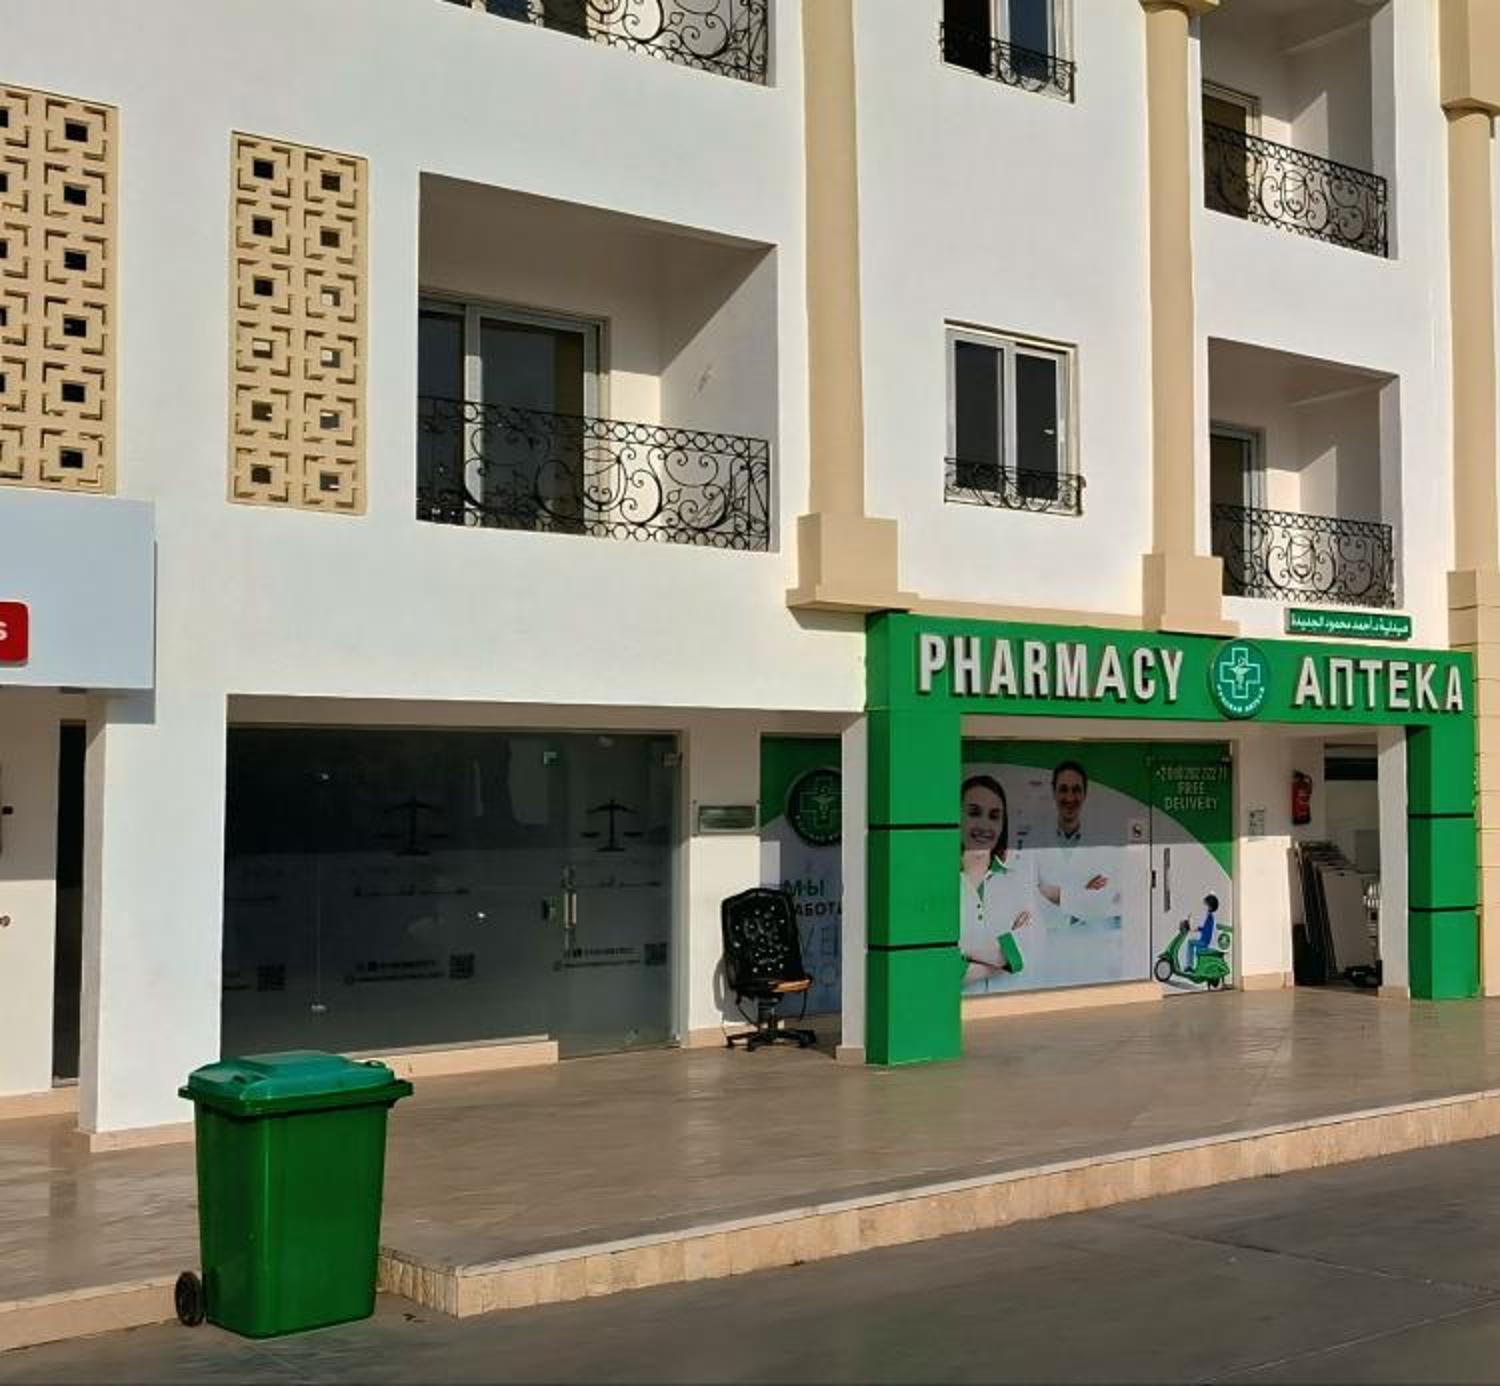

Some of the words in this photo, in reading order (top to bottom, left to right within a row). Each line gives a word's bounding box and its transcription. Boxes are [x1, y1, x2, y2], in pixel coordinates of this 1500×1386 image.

[919, 632, 1184, 701] PHARMACY
[1294, 655, 1464, 711] АПТЕКА
[1164, 796, 1218, 811] DELIVERY
[1177, 781, 1204, 795] FREE
